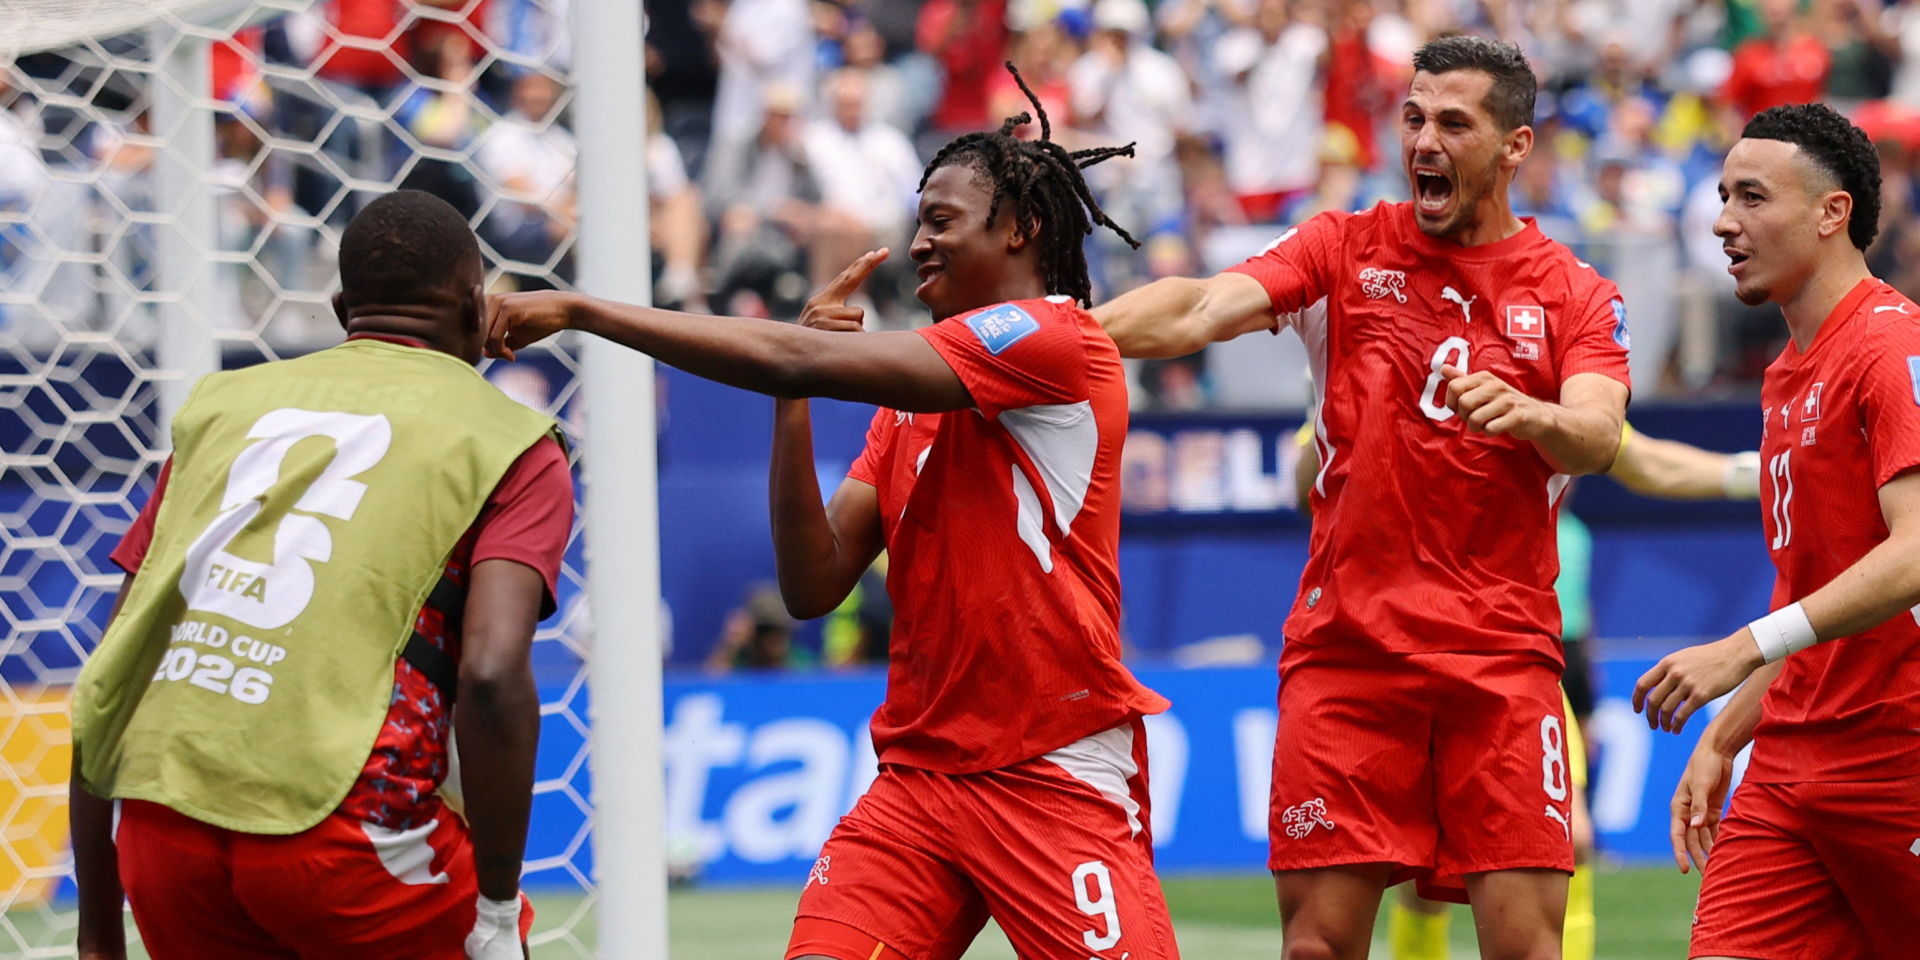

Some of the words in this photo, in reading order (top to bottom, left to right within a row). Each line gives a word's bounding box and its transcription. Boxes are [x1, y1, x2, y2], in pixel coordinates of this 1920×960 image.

[1419, 336, 1471, 421] 8
[1769, 448, 1793, 550] 17
[205, 564, 267, 604] FIFA
[152, 647, 274, 705] 2026
[231, 635, 287, 666] CUP
[1540, 714, 1568, 802] 8
[1071, 860, 1123, 952] 9
